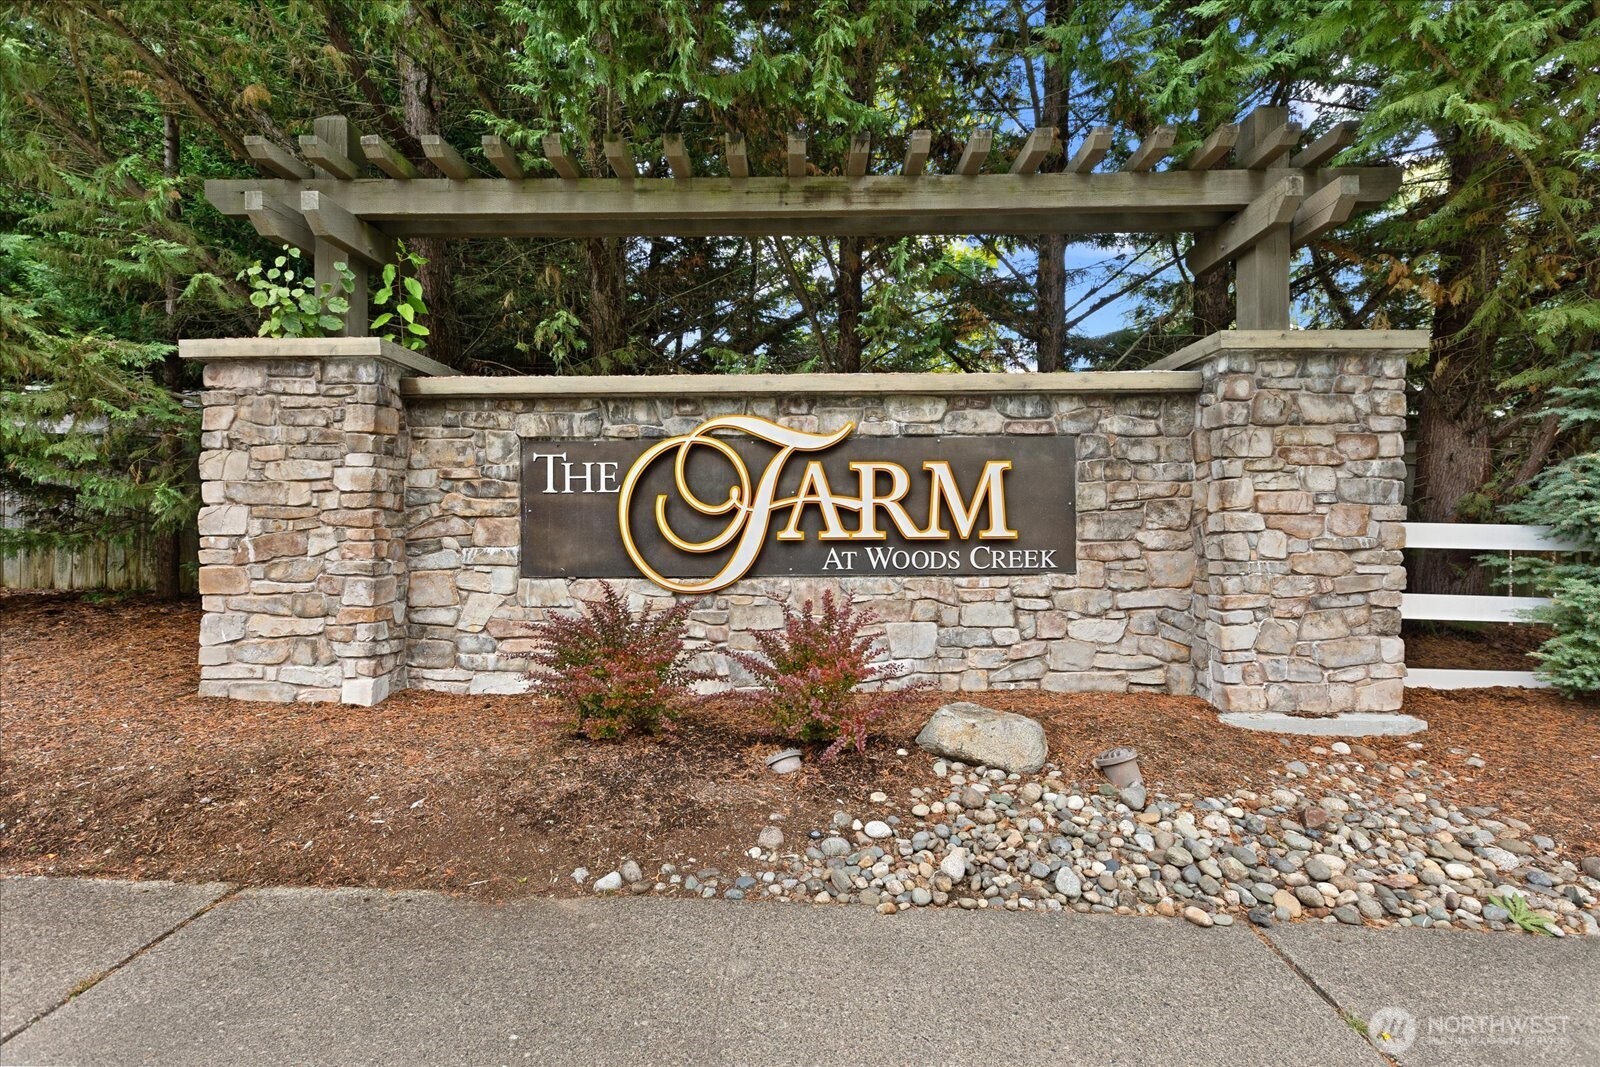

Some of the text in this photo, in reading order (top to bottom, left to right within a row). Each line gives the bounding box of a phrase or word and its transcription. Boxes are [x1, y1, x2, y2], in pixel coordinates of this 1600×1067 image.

[532, 414, 1018, 593] THE FARM
[821, 545, 1058, 570] AT WOODS CREEK
